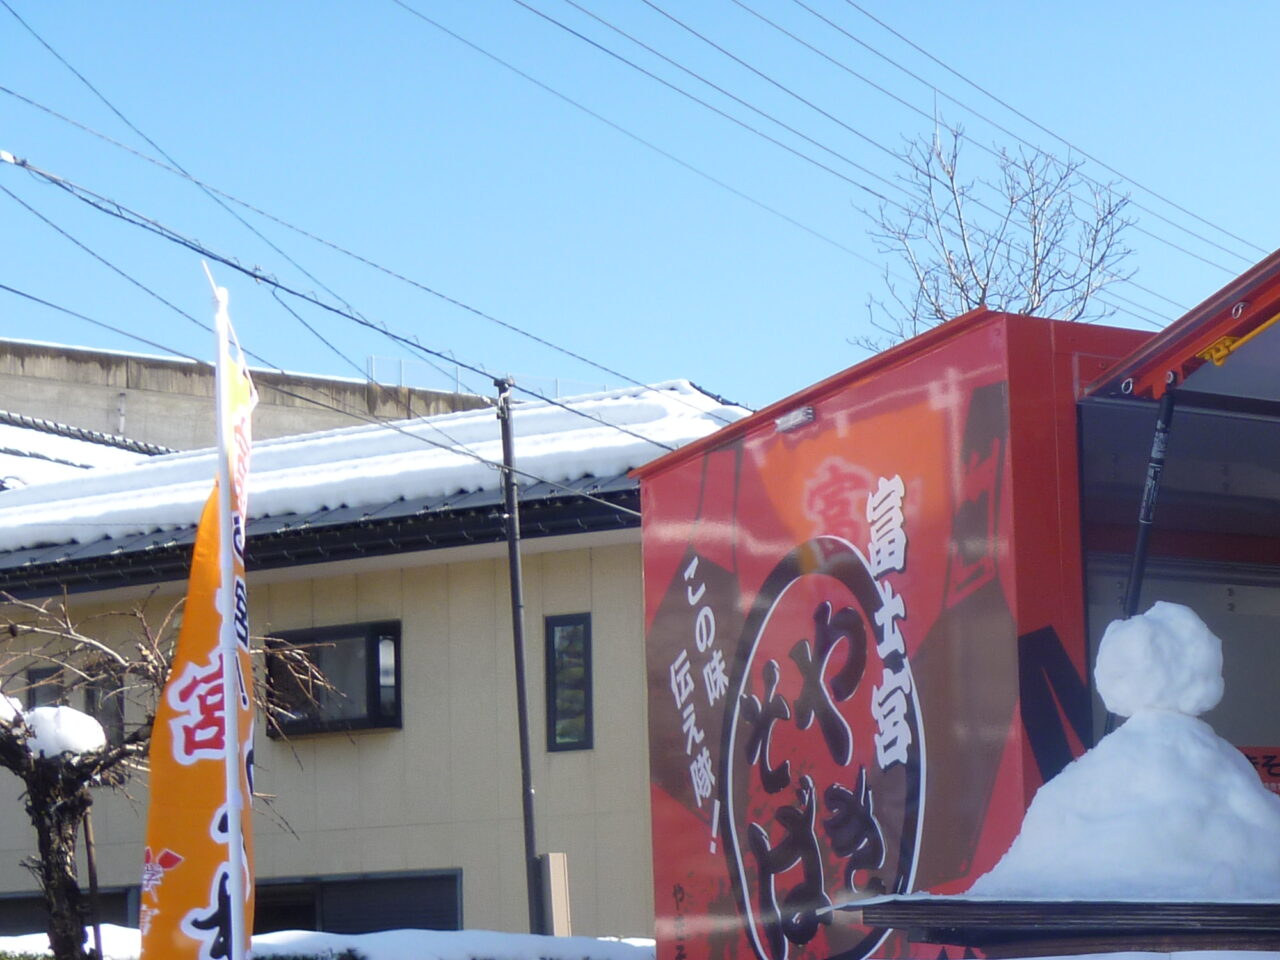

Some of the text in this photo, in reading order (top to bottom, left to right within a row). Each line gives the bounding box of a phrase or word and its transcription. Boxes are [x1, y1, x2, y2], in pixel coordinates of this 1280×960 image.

[682, 555, 730, 706] この味
[866, 474, 912, 770] 富士宮
